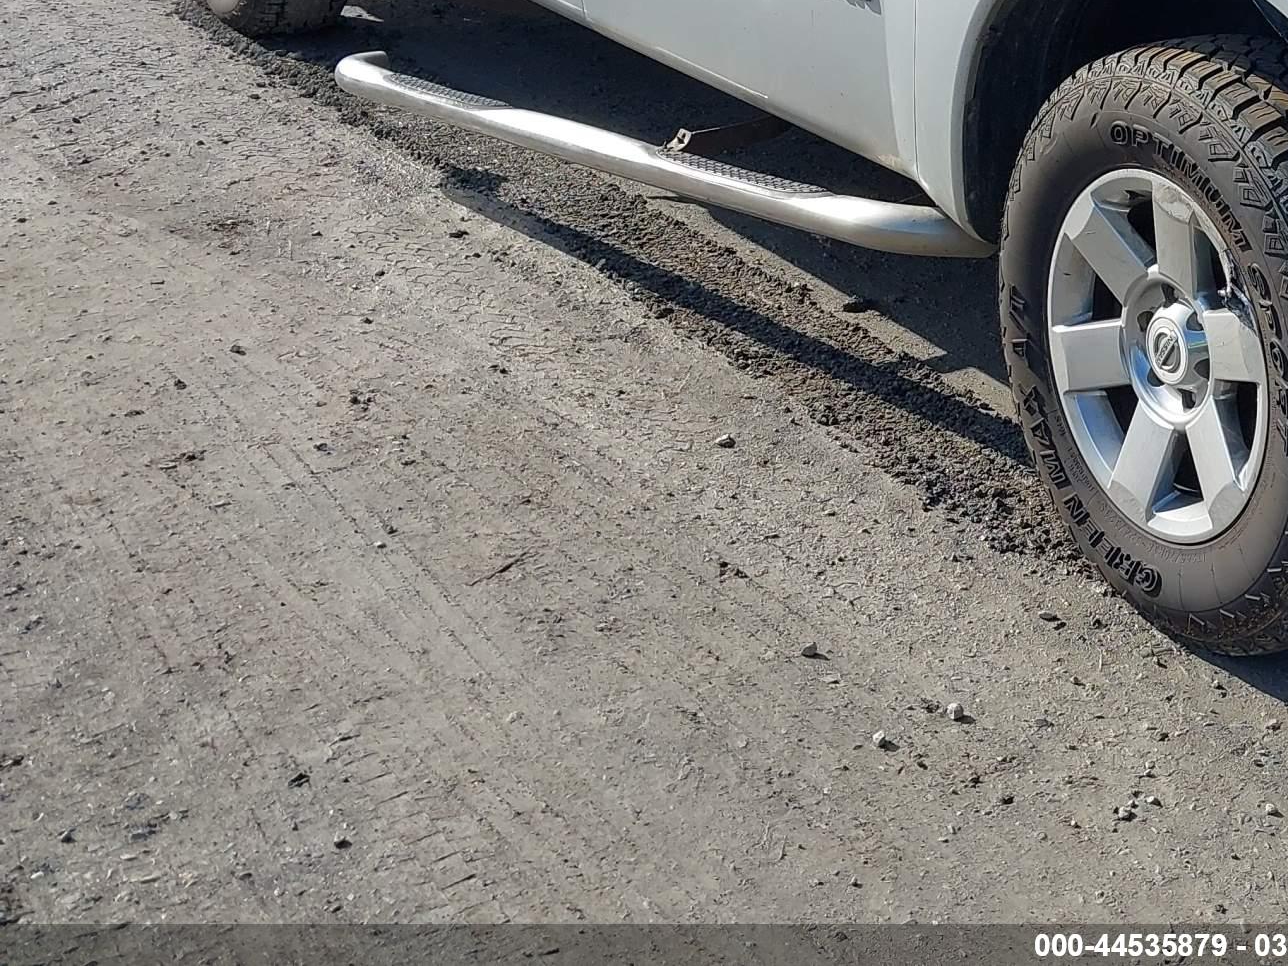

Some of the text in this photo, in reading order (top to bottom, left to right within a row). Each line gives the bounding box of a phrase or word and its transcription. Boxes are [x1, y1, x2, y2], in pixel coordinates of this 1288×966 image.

[1110, 120, 1253, 252] OPTIMUM
[1022, 384, 1067, 489] MAX
[1063, 493, 1163, 596] GREEN
